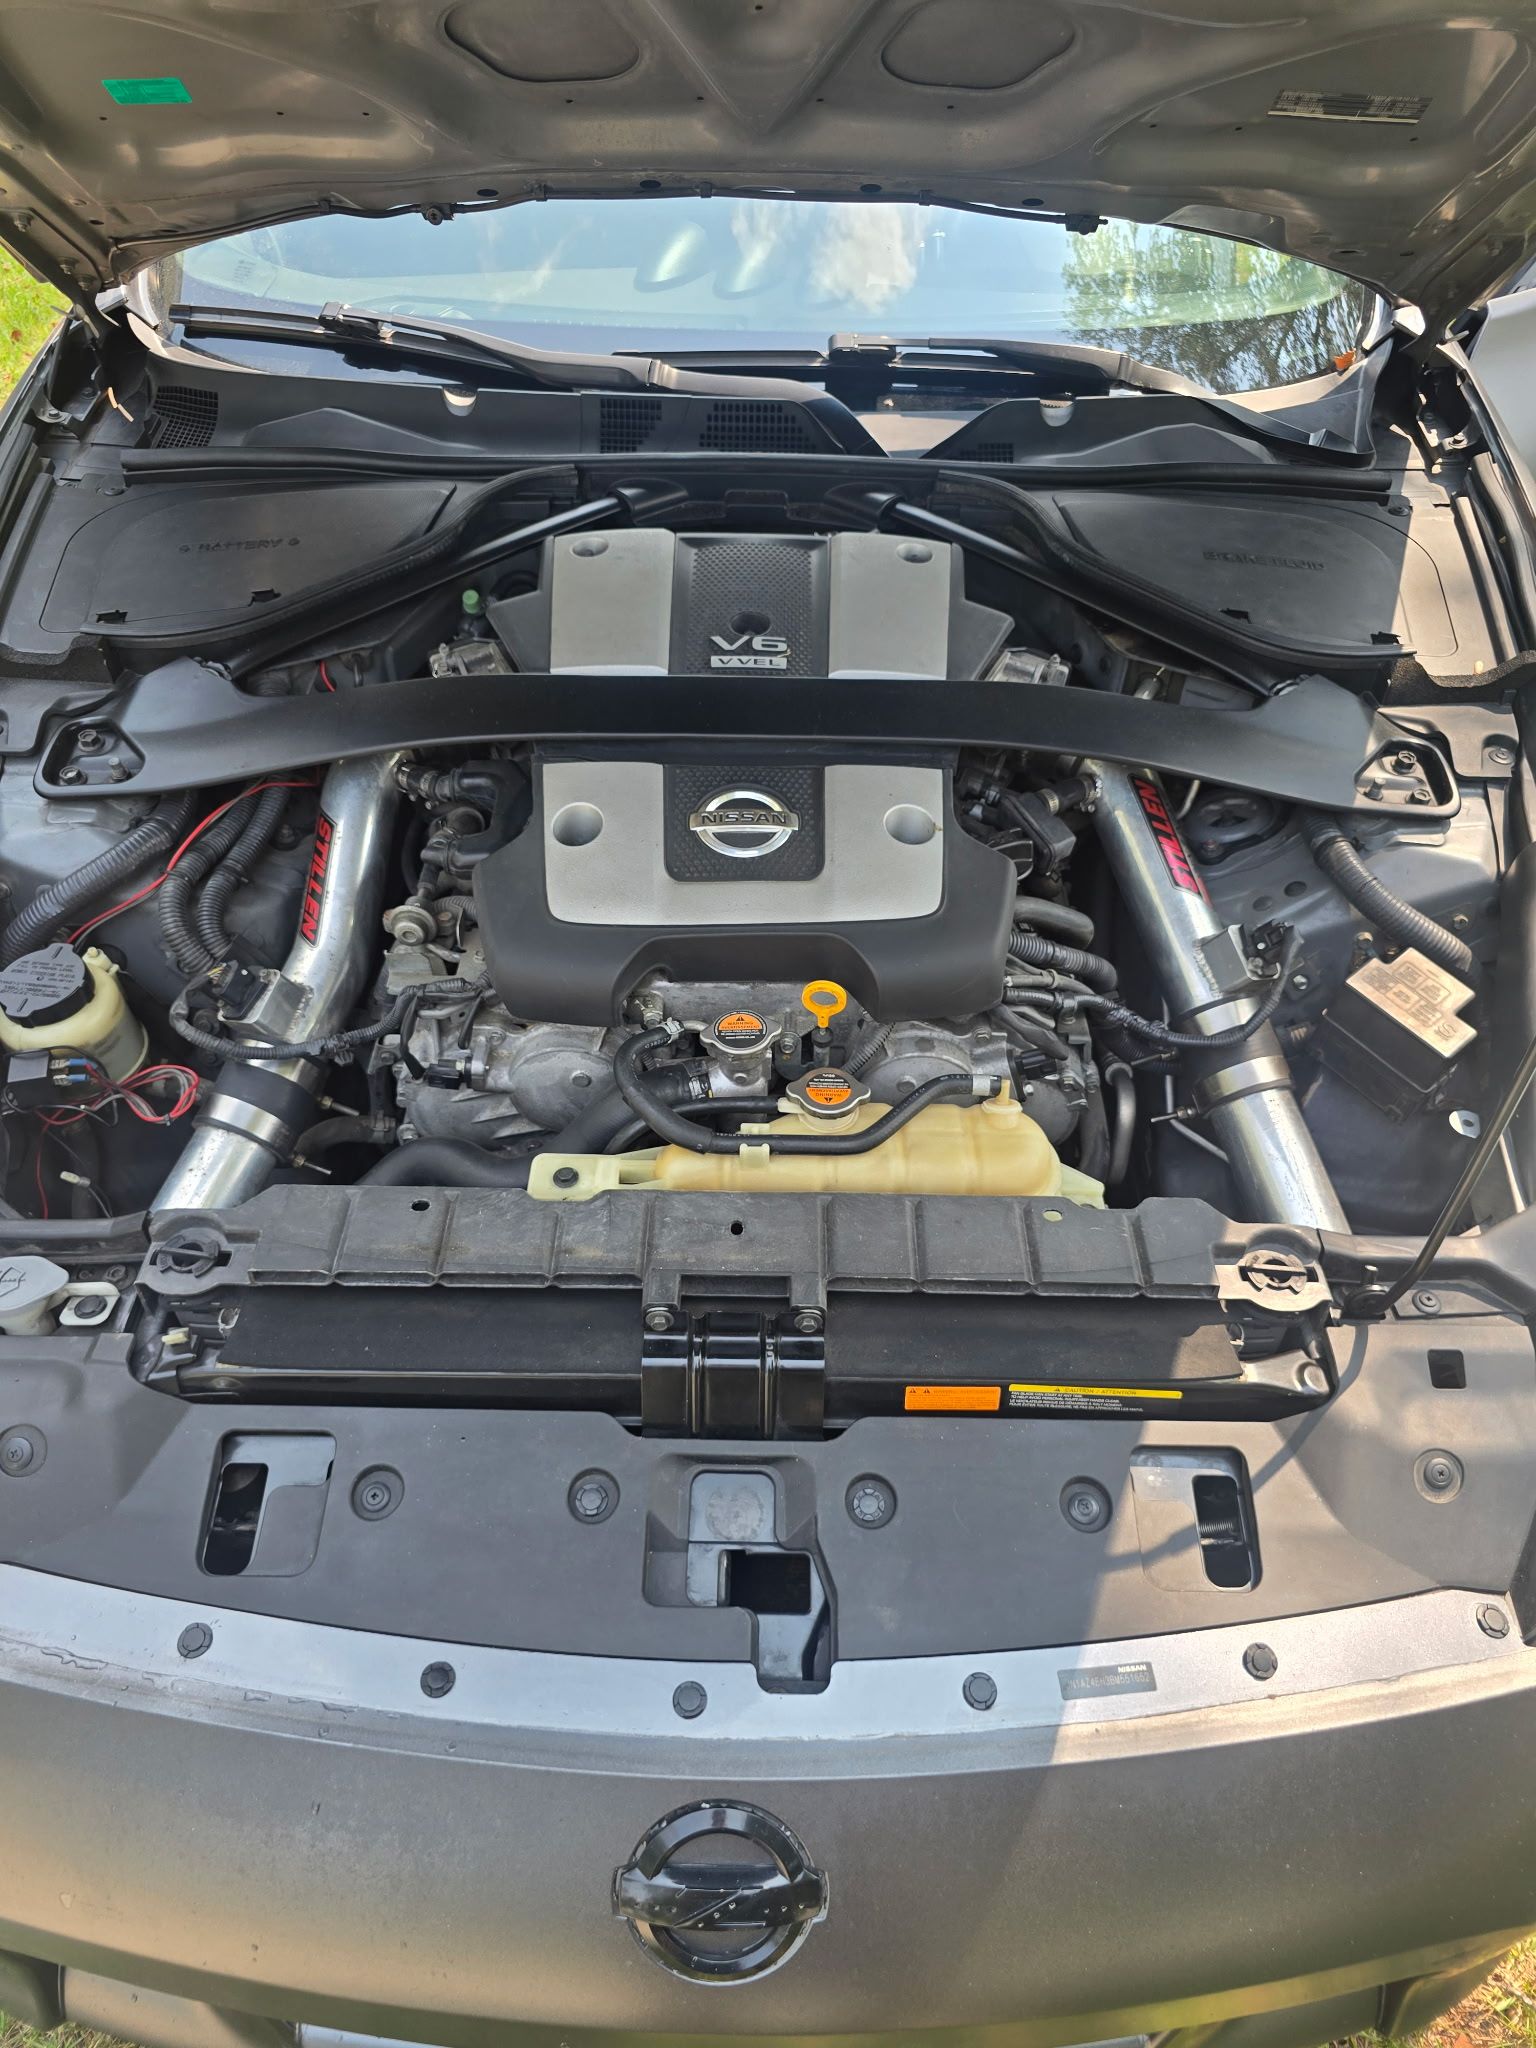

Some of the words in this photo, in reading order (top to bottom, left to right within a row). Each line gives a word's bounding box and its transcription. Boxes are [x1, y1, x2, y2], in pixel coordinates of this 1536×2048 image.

[710, 635, 788, 651] V6
[718, 658, 782, 667] VVEL
[701, 811, 787, 825] NISSAN
[1133, 779, 1200, 894] STILLEN
[301, 816, 334, 942] STILLEN
[1117, 1663, 1147, 1673] NISSAN
